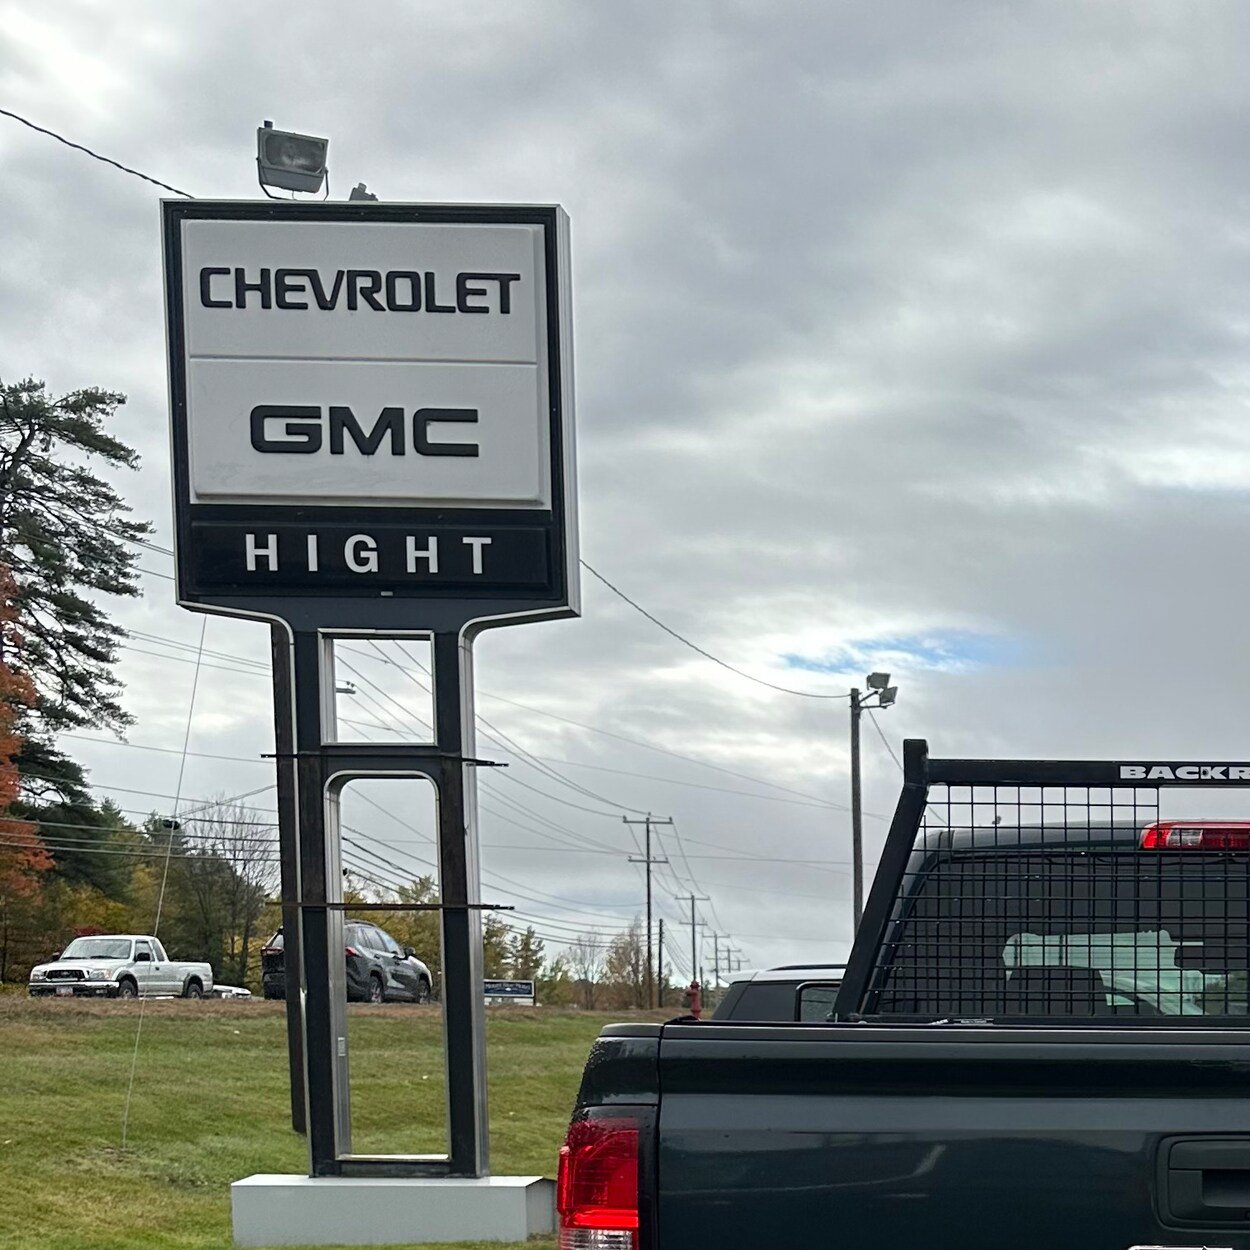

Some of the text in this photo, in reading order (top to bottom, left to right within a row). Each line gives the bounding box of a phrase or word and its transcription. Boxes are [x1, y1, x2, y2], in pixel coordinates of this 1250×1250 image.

[199, 266, 521, 315] CHEVROLET
[250, 404, 479, 457] GMC
[245, 533, 492, 574] HIGHT
